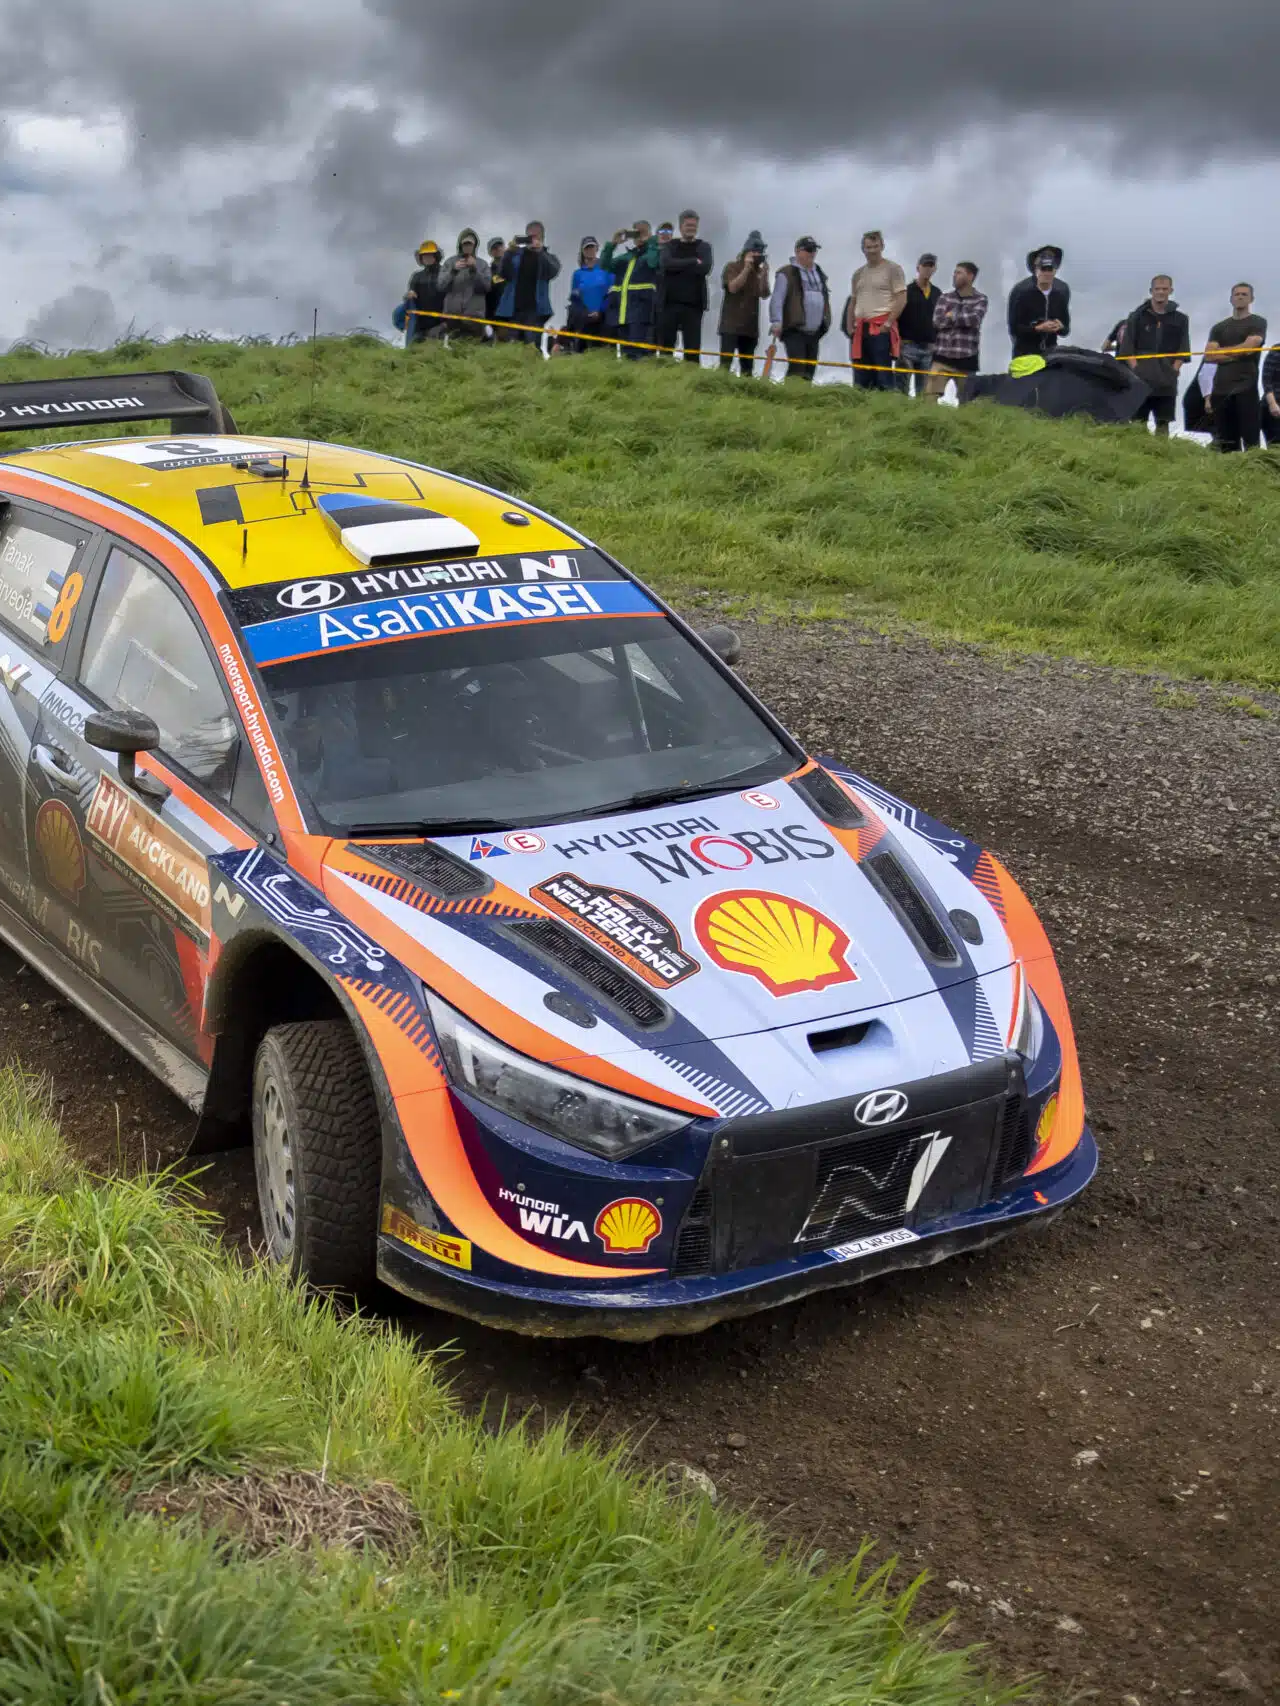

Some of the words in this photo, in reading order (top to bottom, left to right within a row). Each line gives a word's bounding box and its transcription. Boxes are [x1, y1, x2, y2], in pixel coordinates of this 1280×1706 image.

[12, 397, 144, 416] HYUNDAI
[145, 442, 218, 455] 8
[351, 561, 507, 595] HYUNDAI
[48, 571, 84, 643] 8
[318, 584, 603, 648] AsahiKASEI
[41, 691, 86, 736] INNOCE
[219, 643, 285, 802] motorsport.hyundai.com
[553, 816, 720, 860] HYUNDAI
[629, 823, 835, 884] MOBIS
[128, 824, 209, 907] AUCKLAND
[562, 879, 592, 898] 2022
[545, 883, 593, 914] NEW
[587, 911, 679, 979] ZEALAND
[569, 916, 626, 958] AUCKLAND
[588, 896, 663, 945] RALLY
[499, 1188, 559, 1213] HYUNDAI
[838, 1242, 869, 1257] ALZ
[867, 1237, 886, 1248] WR
[885, 1230, 913, 1243] 905
